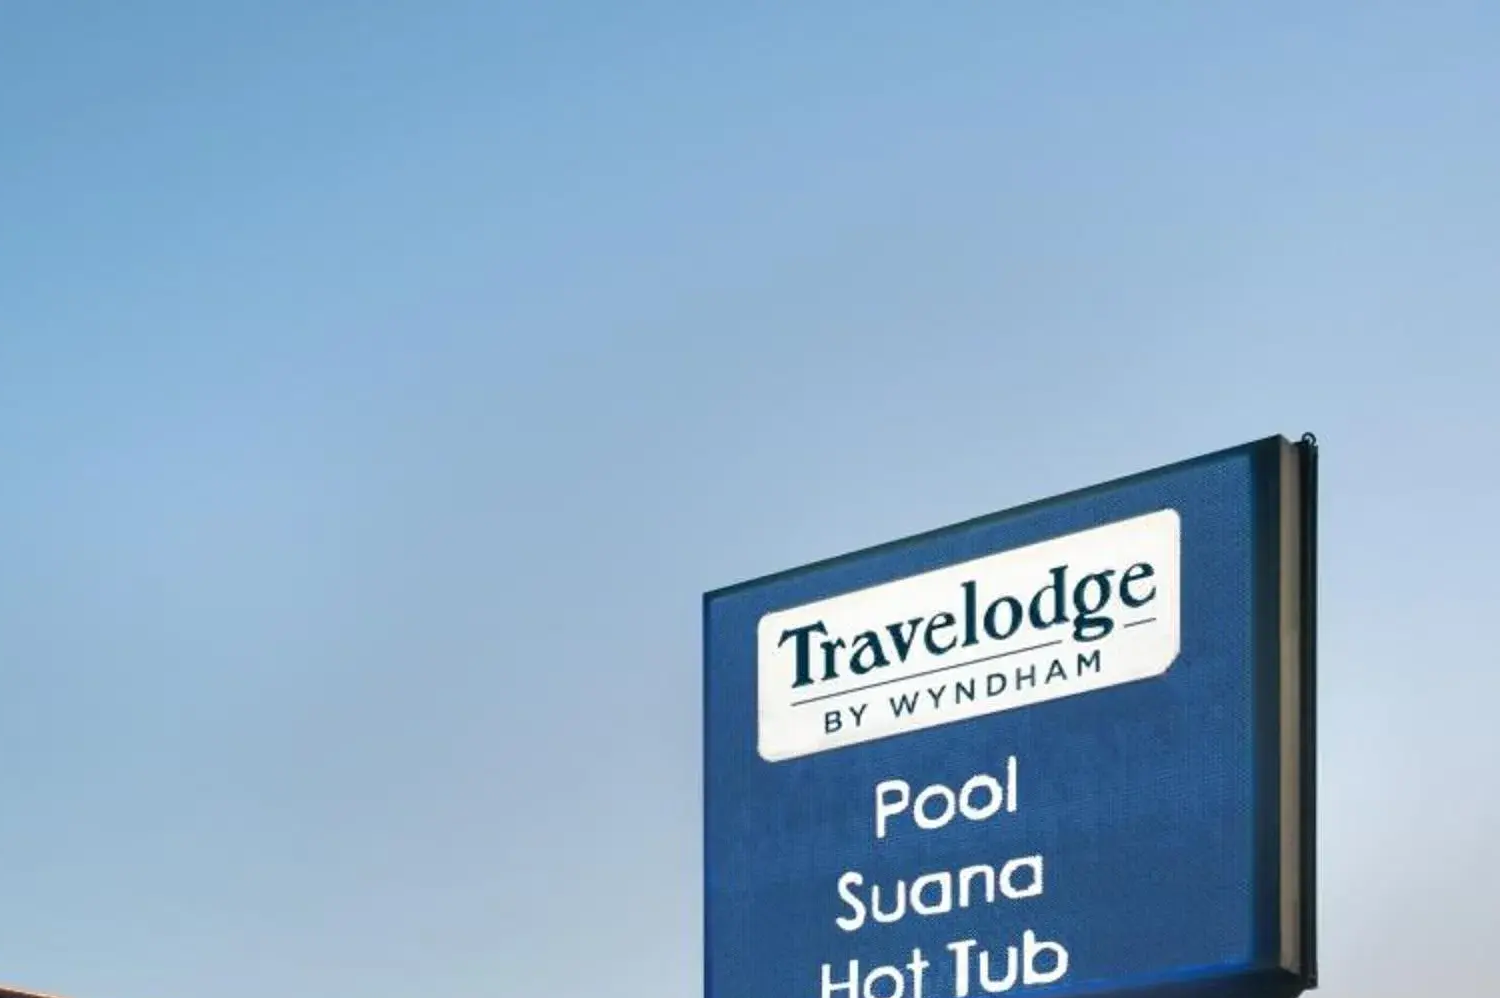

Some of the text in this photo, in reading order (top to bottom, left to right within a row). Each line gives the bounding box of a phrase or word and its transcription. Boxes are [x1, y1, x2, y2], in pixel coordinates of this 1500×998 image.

[777, 562, 1157, 689] Travelodge
[824, 649, 1102, 734] BY WYNDHAM
[875, 755, 1018, 839] Pool
[835, 854, 1044, 932] Suana
[946, 929, 1069, 998] Tub
